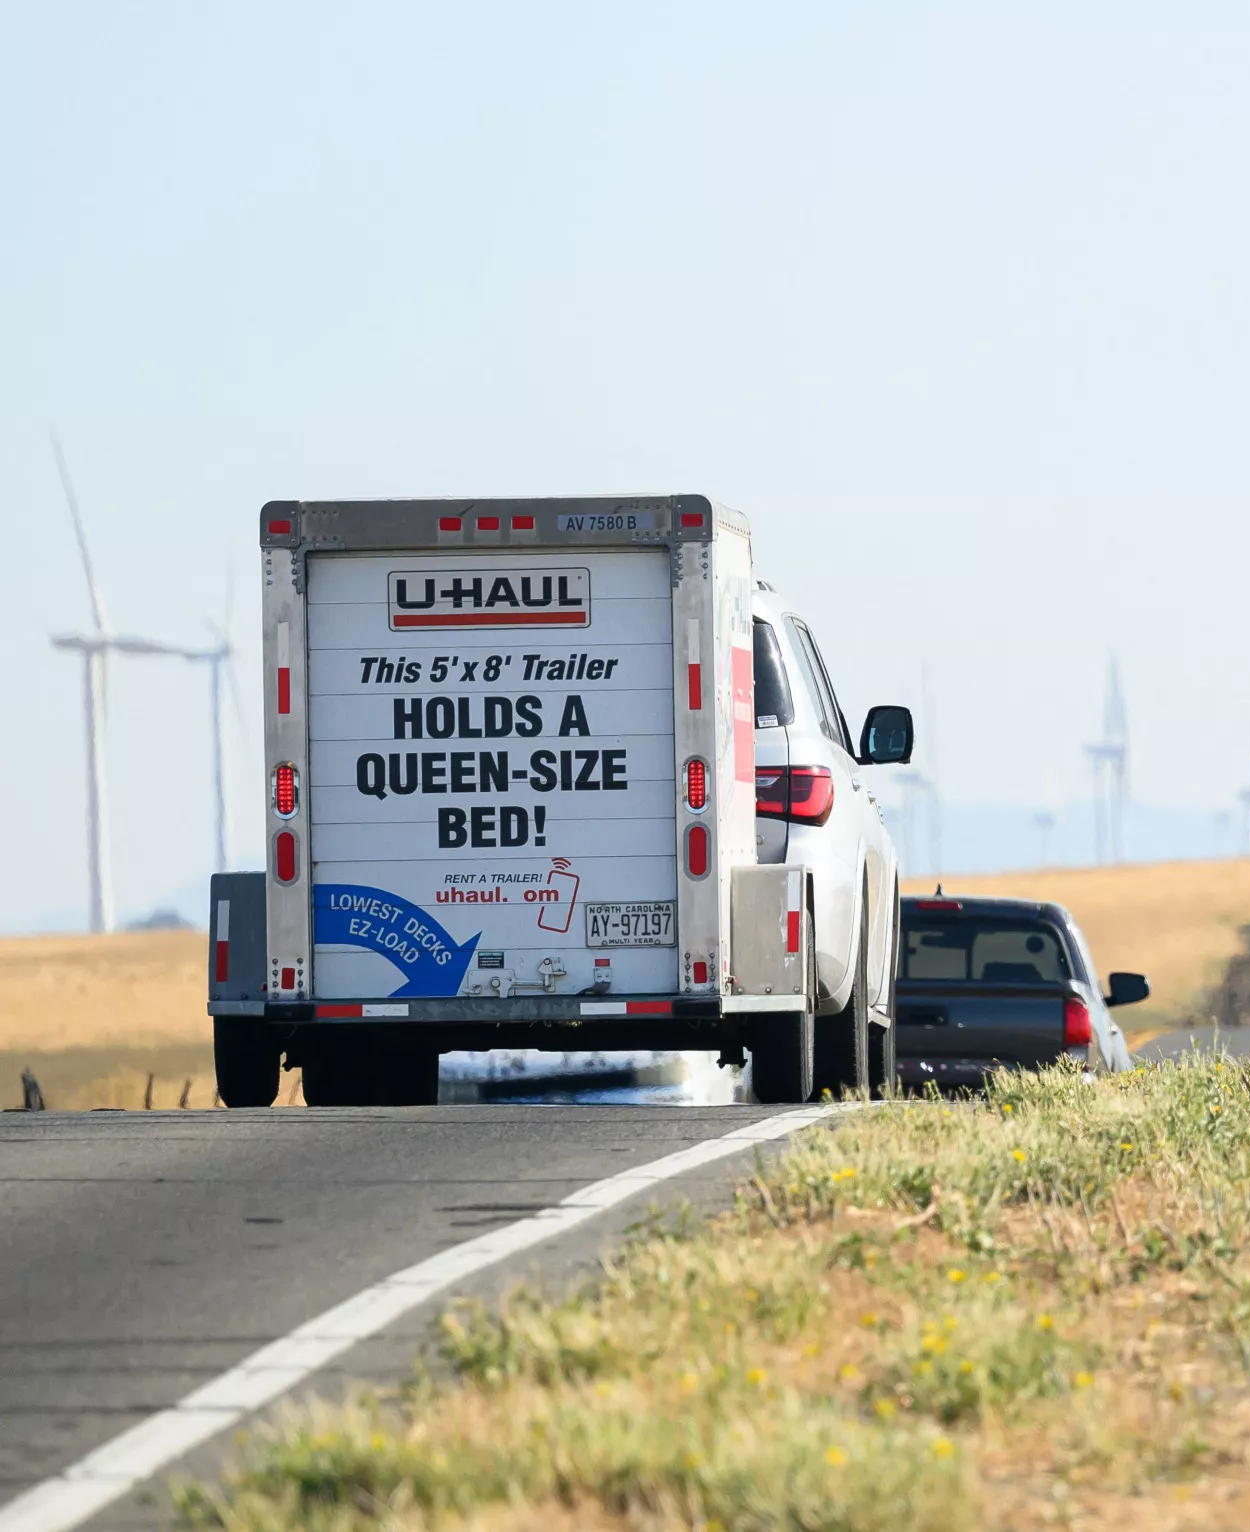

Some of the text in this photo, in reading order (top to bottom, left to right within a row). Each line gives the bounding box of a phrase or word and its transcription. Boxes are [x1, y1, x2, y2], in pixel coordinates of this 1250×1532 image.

[566, 516, 637, 531] AV 7580 B
[396, 575, 582, 609] U-HAUL
[360, 656, 421, 684] This
[482, 655, 511, 682] 8'
[522, 653, 618, 681] Trailer
[393, 694, 591, 740] HOLDS A
[356, 748, 628, 800] QUEEN-SIZE
[437, 805, 547, 849] BED!
[445, 874, 543, 884] RENT A TRAILER!
[589, 906, 621, 914] NORTH
[591, 913, 672, 937] AY-97197
[330, 894, 403, 924] LOWEST
[404, 917, 452, 965] DECKS
[349, 918, 420, 964] EZ-LOAD
